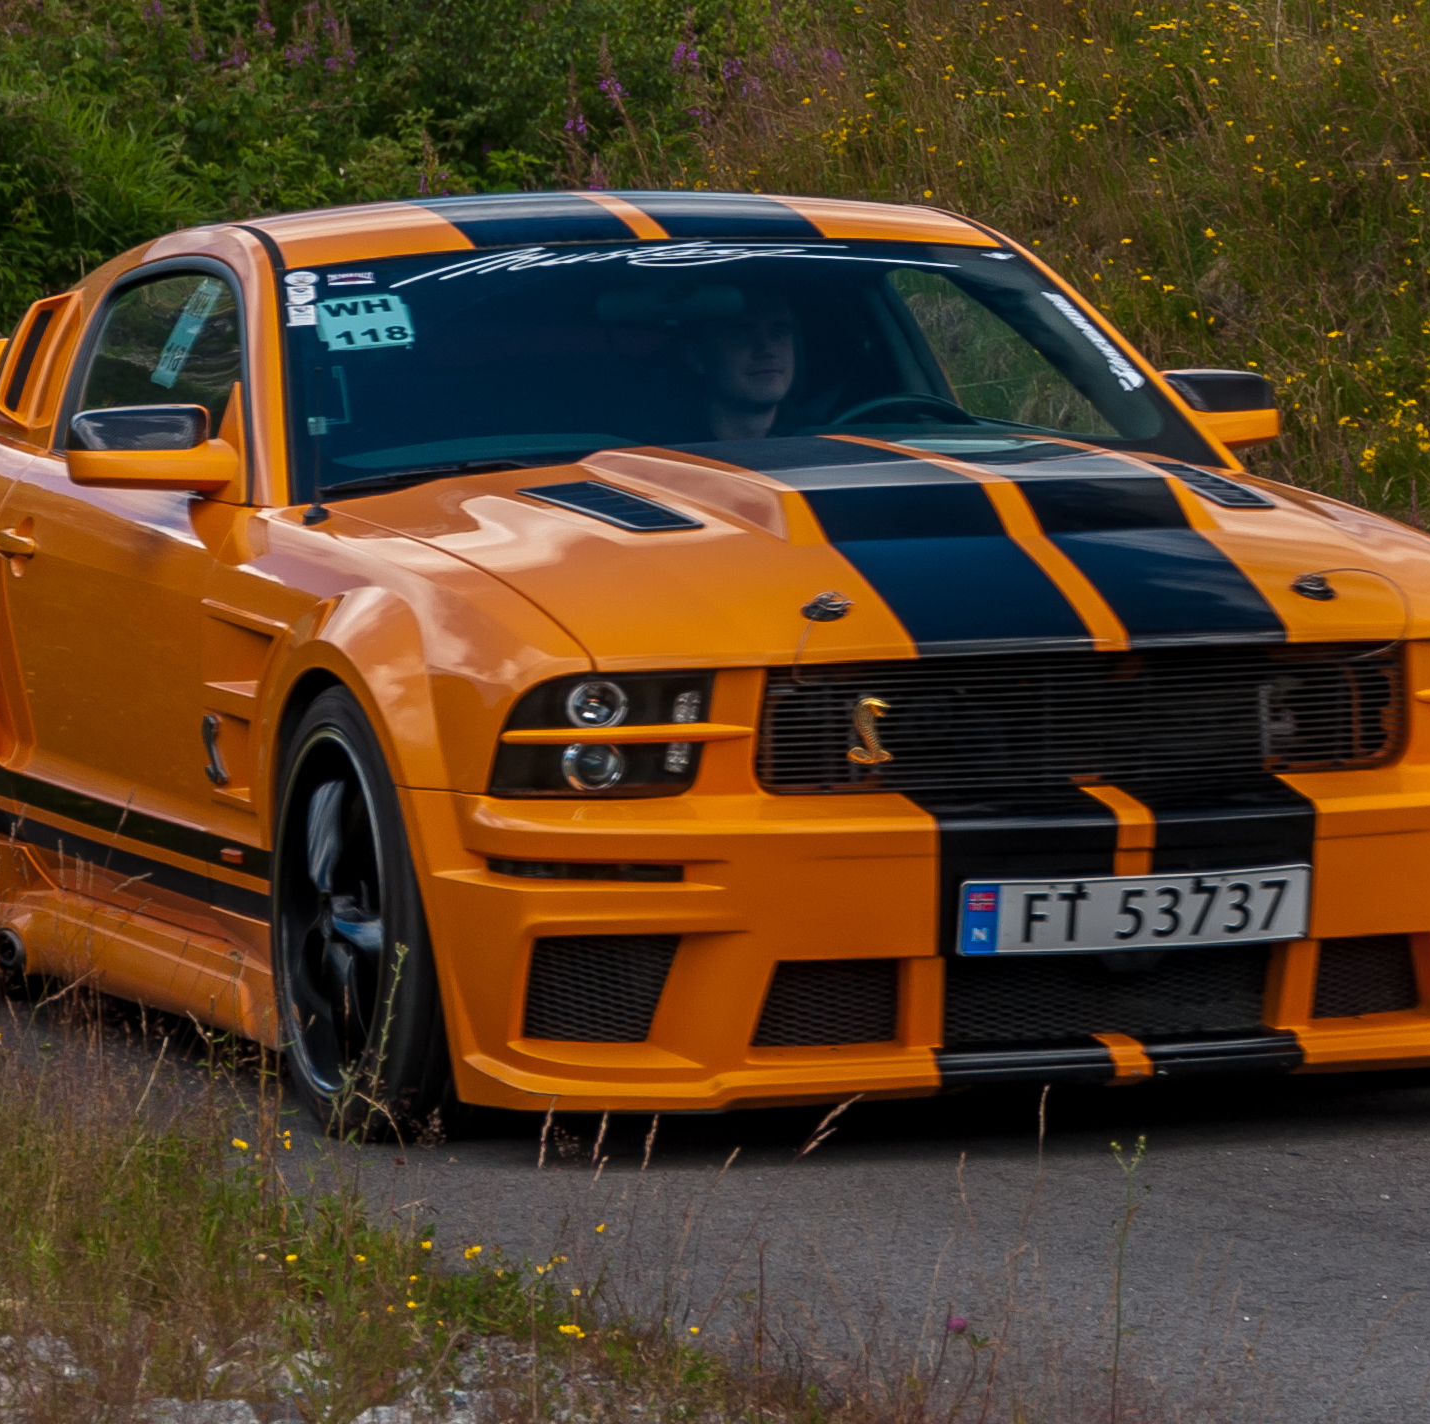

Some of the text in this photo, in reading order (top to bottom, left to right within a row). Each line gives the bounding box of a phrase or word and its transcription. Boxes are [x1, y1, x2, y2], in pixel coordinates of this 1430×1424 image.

[389, 241, 962, 288] Mustang
[322, 298, 392, 317] WH
[335, 326, 409, 345] 118
[1023, 878, 1291, 943] FT 53737
[972, 927, 989, 942] N
